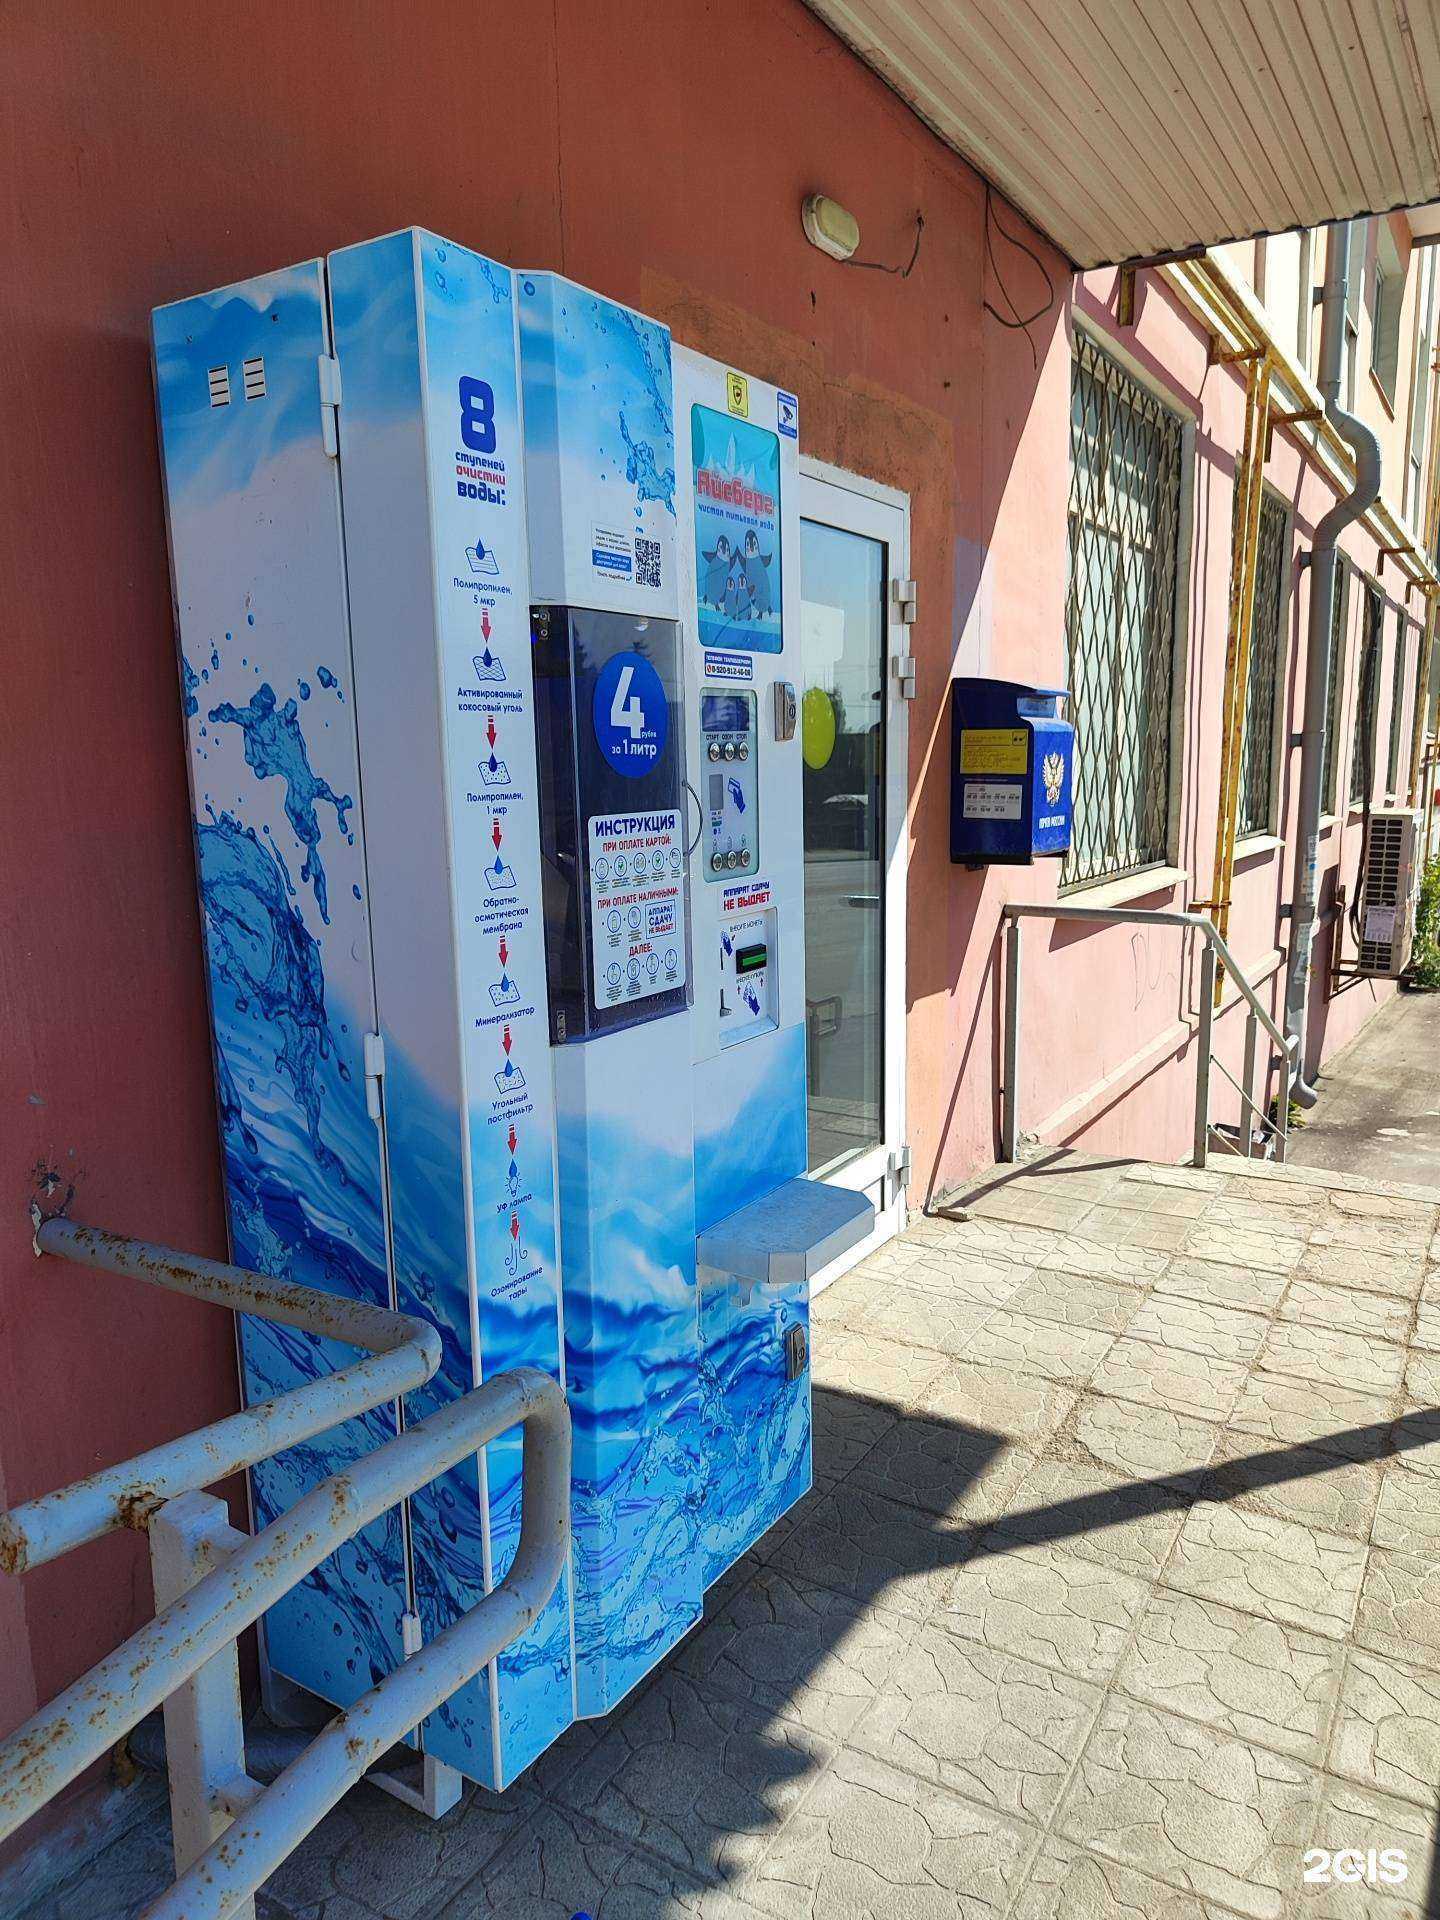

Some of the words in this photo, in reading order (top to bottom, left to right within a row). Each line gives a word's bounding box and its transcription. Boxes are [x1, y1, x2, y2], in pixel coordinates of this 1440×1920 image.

[459, 376, 496, 454] 8
[455, 451, 505, 472] ступеней
[456, 464, 506, 486] очистки
[457, 481, 506, 506] воды:
[453, 577, 513, 596] Полипропилен,
[473, 594, 479, 605] 5
[480, 597, 496, 608] мкр
[457, 687, 523, 700] Активированный
[458, 701, 501, 714] кокосовый
[502, 704, 523, 715] уголь
[610, 666, 645, 739] 4
[612, 746, 620, 754] за
[623, 738, 628, 754] 1
[630, 743, 657, 760] литр
[466, 792, 524, 803] Полипропилен,
[486, 806, 490, 815] 1
[492, 806, 508, 816] мкр
[595, 815, 675, 837] ИНСТРУКЦИЯ
[603, 842, 617, 852] ПРИ
[619, 838, 644, 850] ОПЛАТЕ
[646, 833, 672, 847] КАРТОЙ:
[723, 885, 750, 898] АППАРАТ
[751, 881, 770, 892] СДАЧУ
[483, 896, 519, 908] Обратно-
[597, 898, 611, 909] ПРИ
[613, 893, 637, 906] ОПЛАТЕ
[723, 898, 735, 911] НЕ
[737, 891, 770, 909] ВЫДАЕТ
[474, 906, 529, 923] осмотическая
[648, 904, 673, 916] АППАРАТ
[482, 920, 523, 935] мембрана
[649, 914, 673, 926] СДАЧУ
[648, 927, 655, 935] НЕ
[629, 942, 653, 957] ДАЛЕЕ:
[475, 1007, 535, 1028] Минерализатор
[491, 1092, 529, 1111] Угольный
[487, 1103, 533, 1125] постфильтр
[509, 1193, 532, 1208] лампа
[490, 1266, 543, 1297] Озонирование
[508, 1287, 528, 1300] тары
